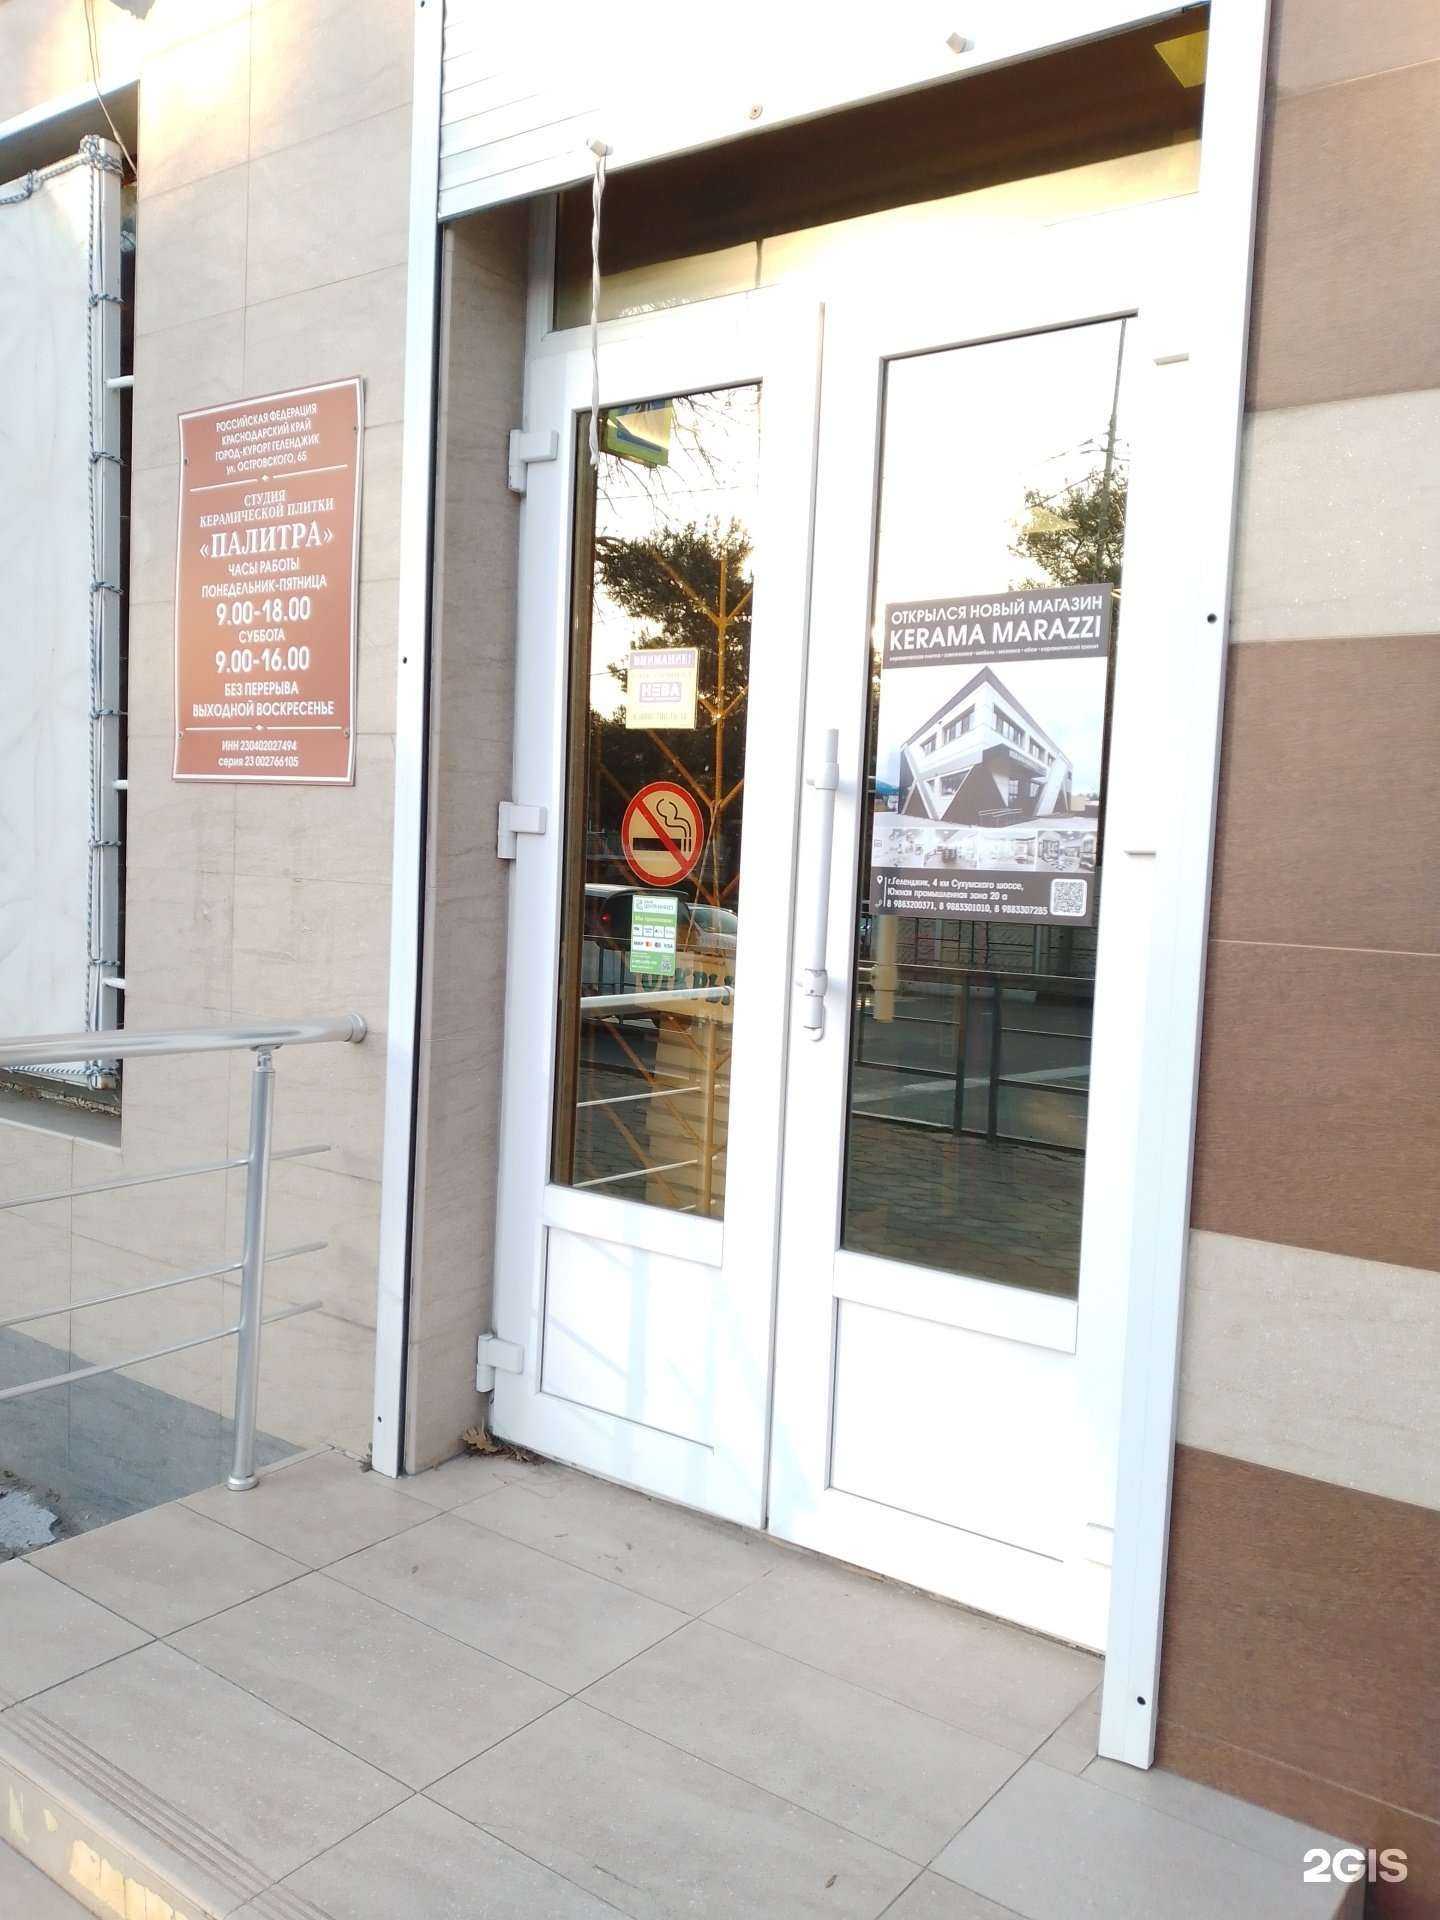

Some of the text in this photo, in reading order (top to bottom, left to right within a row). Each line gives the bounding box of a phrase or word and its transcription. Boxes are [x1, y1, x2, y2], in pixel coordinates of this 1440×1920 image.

[216, 404, 317, 432] РОССИЙСКАЯ ФЕДЕРАЦИЯ
[222, 418, 311, 445] КРАСНОДАРСКИЙ КРАЙ
[215, 433, 320, 461] ГОРОД-КУРОРТ ГЕЛЕНДЖИК
[226, 464, 236, 475] ул.
[297, 451, 307, 462] 65
[244, 490, 287, 507] СТУДИЯ
[200, 498, 335, 528] КЕРАМИЧЕСКОЙ ПЛИТКИ
[200, 520, 333, 558] «ПАЛИТРА»
[228, 556, 300, 576] ЧАСЫ РАБОТЫ
[202, 574, 327, 598] ПОНЕДЕЛЬНИК-ПЯТНИЦА
[216, 595, 311, 625] 9.00-18.00
[891, 595, 1103, 625] ОТКРЫЛСЯ НОВЫЙ МАГАЗИН
[238, 628, 286, 643] СУББОТА
[890, 616, 1101, 651] KERAMA MARAZZI
[215, 646, 310, 673] 9.00-16.00
[224, 681, 299, 696] БЕЗ ПЕРЕРЫВА
[192, 700, 335, 718] ВЫХОДНОЙ ВОСКРЕСЕНЬЕ
[222, 739, 239, 751] ИНН
[218, 757, 244, 769] серия
[244, 756, 254, 767] 23
[932, 878, 938, 887] 4
[990, 891, 1000, 900] 20
